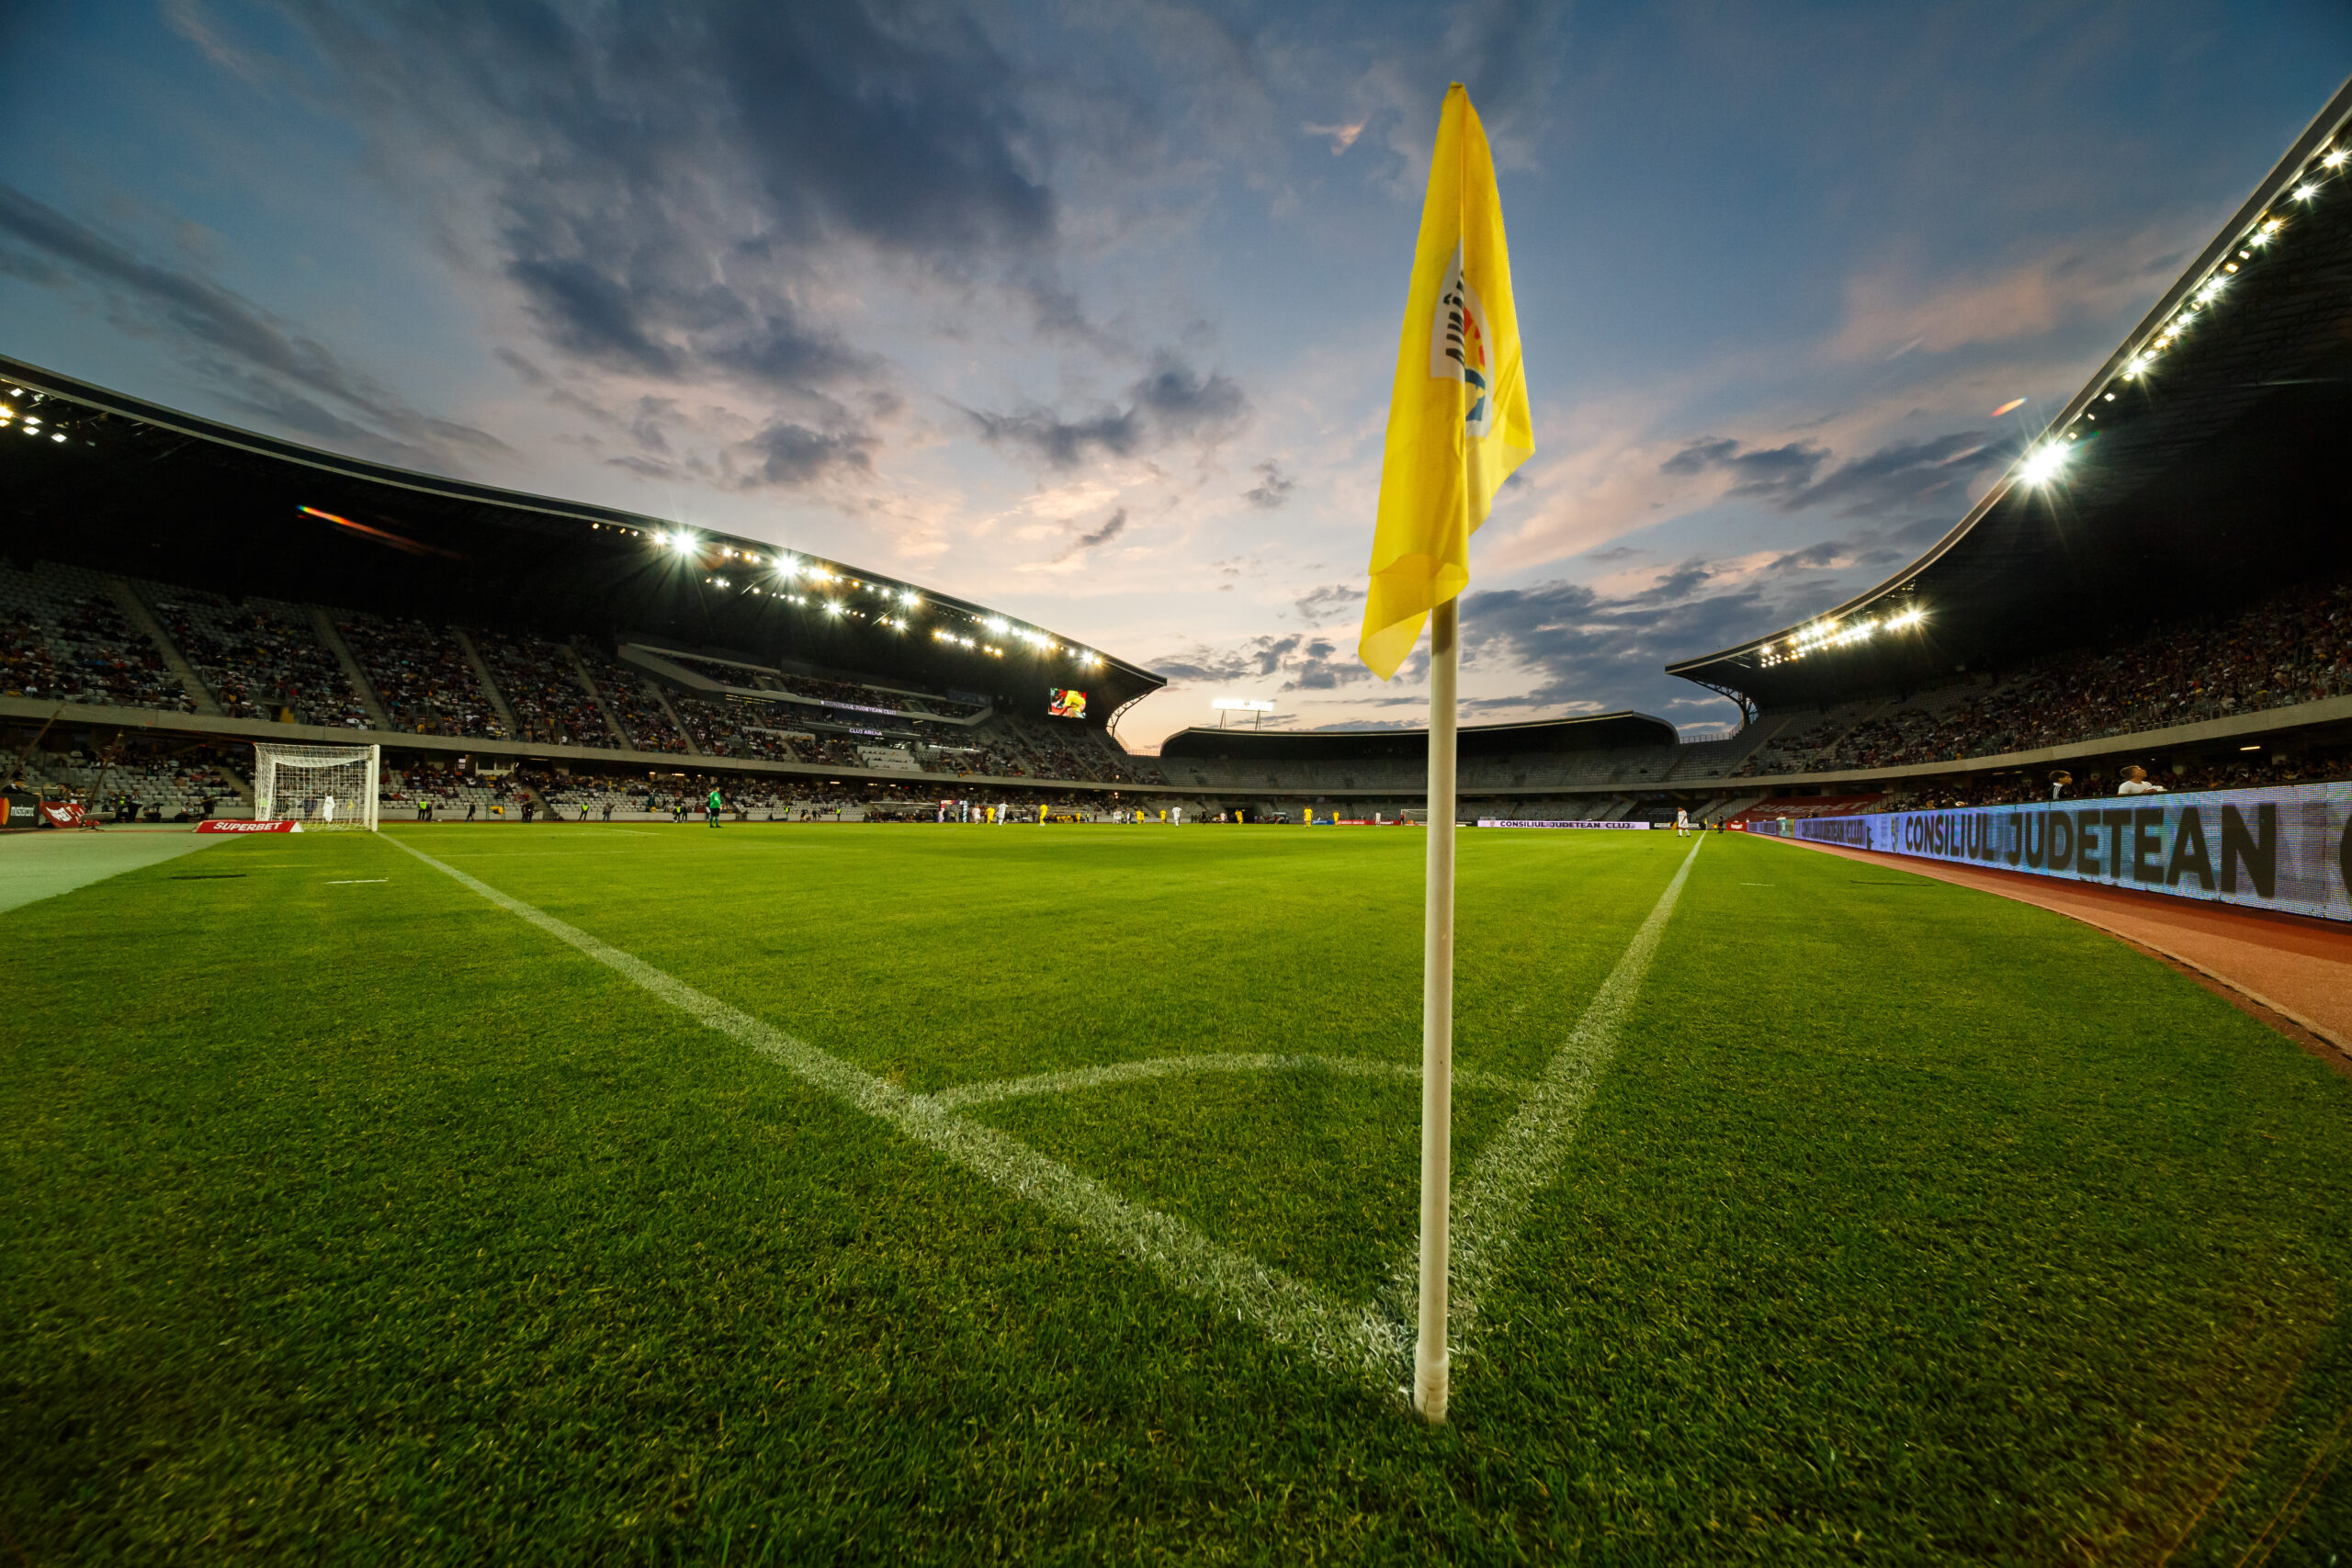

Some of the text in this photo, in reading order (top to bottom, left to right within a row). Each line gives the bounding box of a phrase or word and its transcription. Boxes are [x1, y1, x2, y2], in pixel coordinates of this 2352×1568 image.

[213, 822, 283, 831] SUPERBET
[1905, 812, 1995, 861] CONSILIUL
[2007, 803, 2277, 898] JUDETEAN
